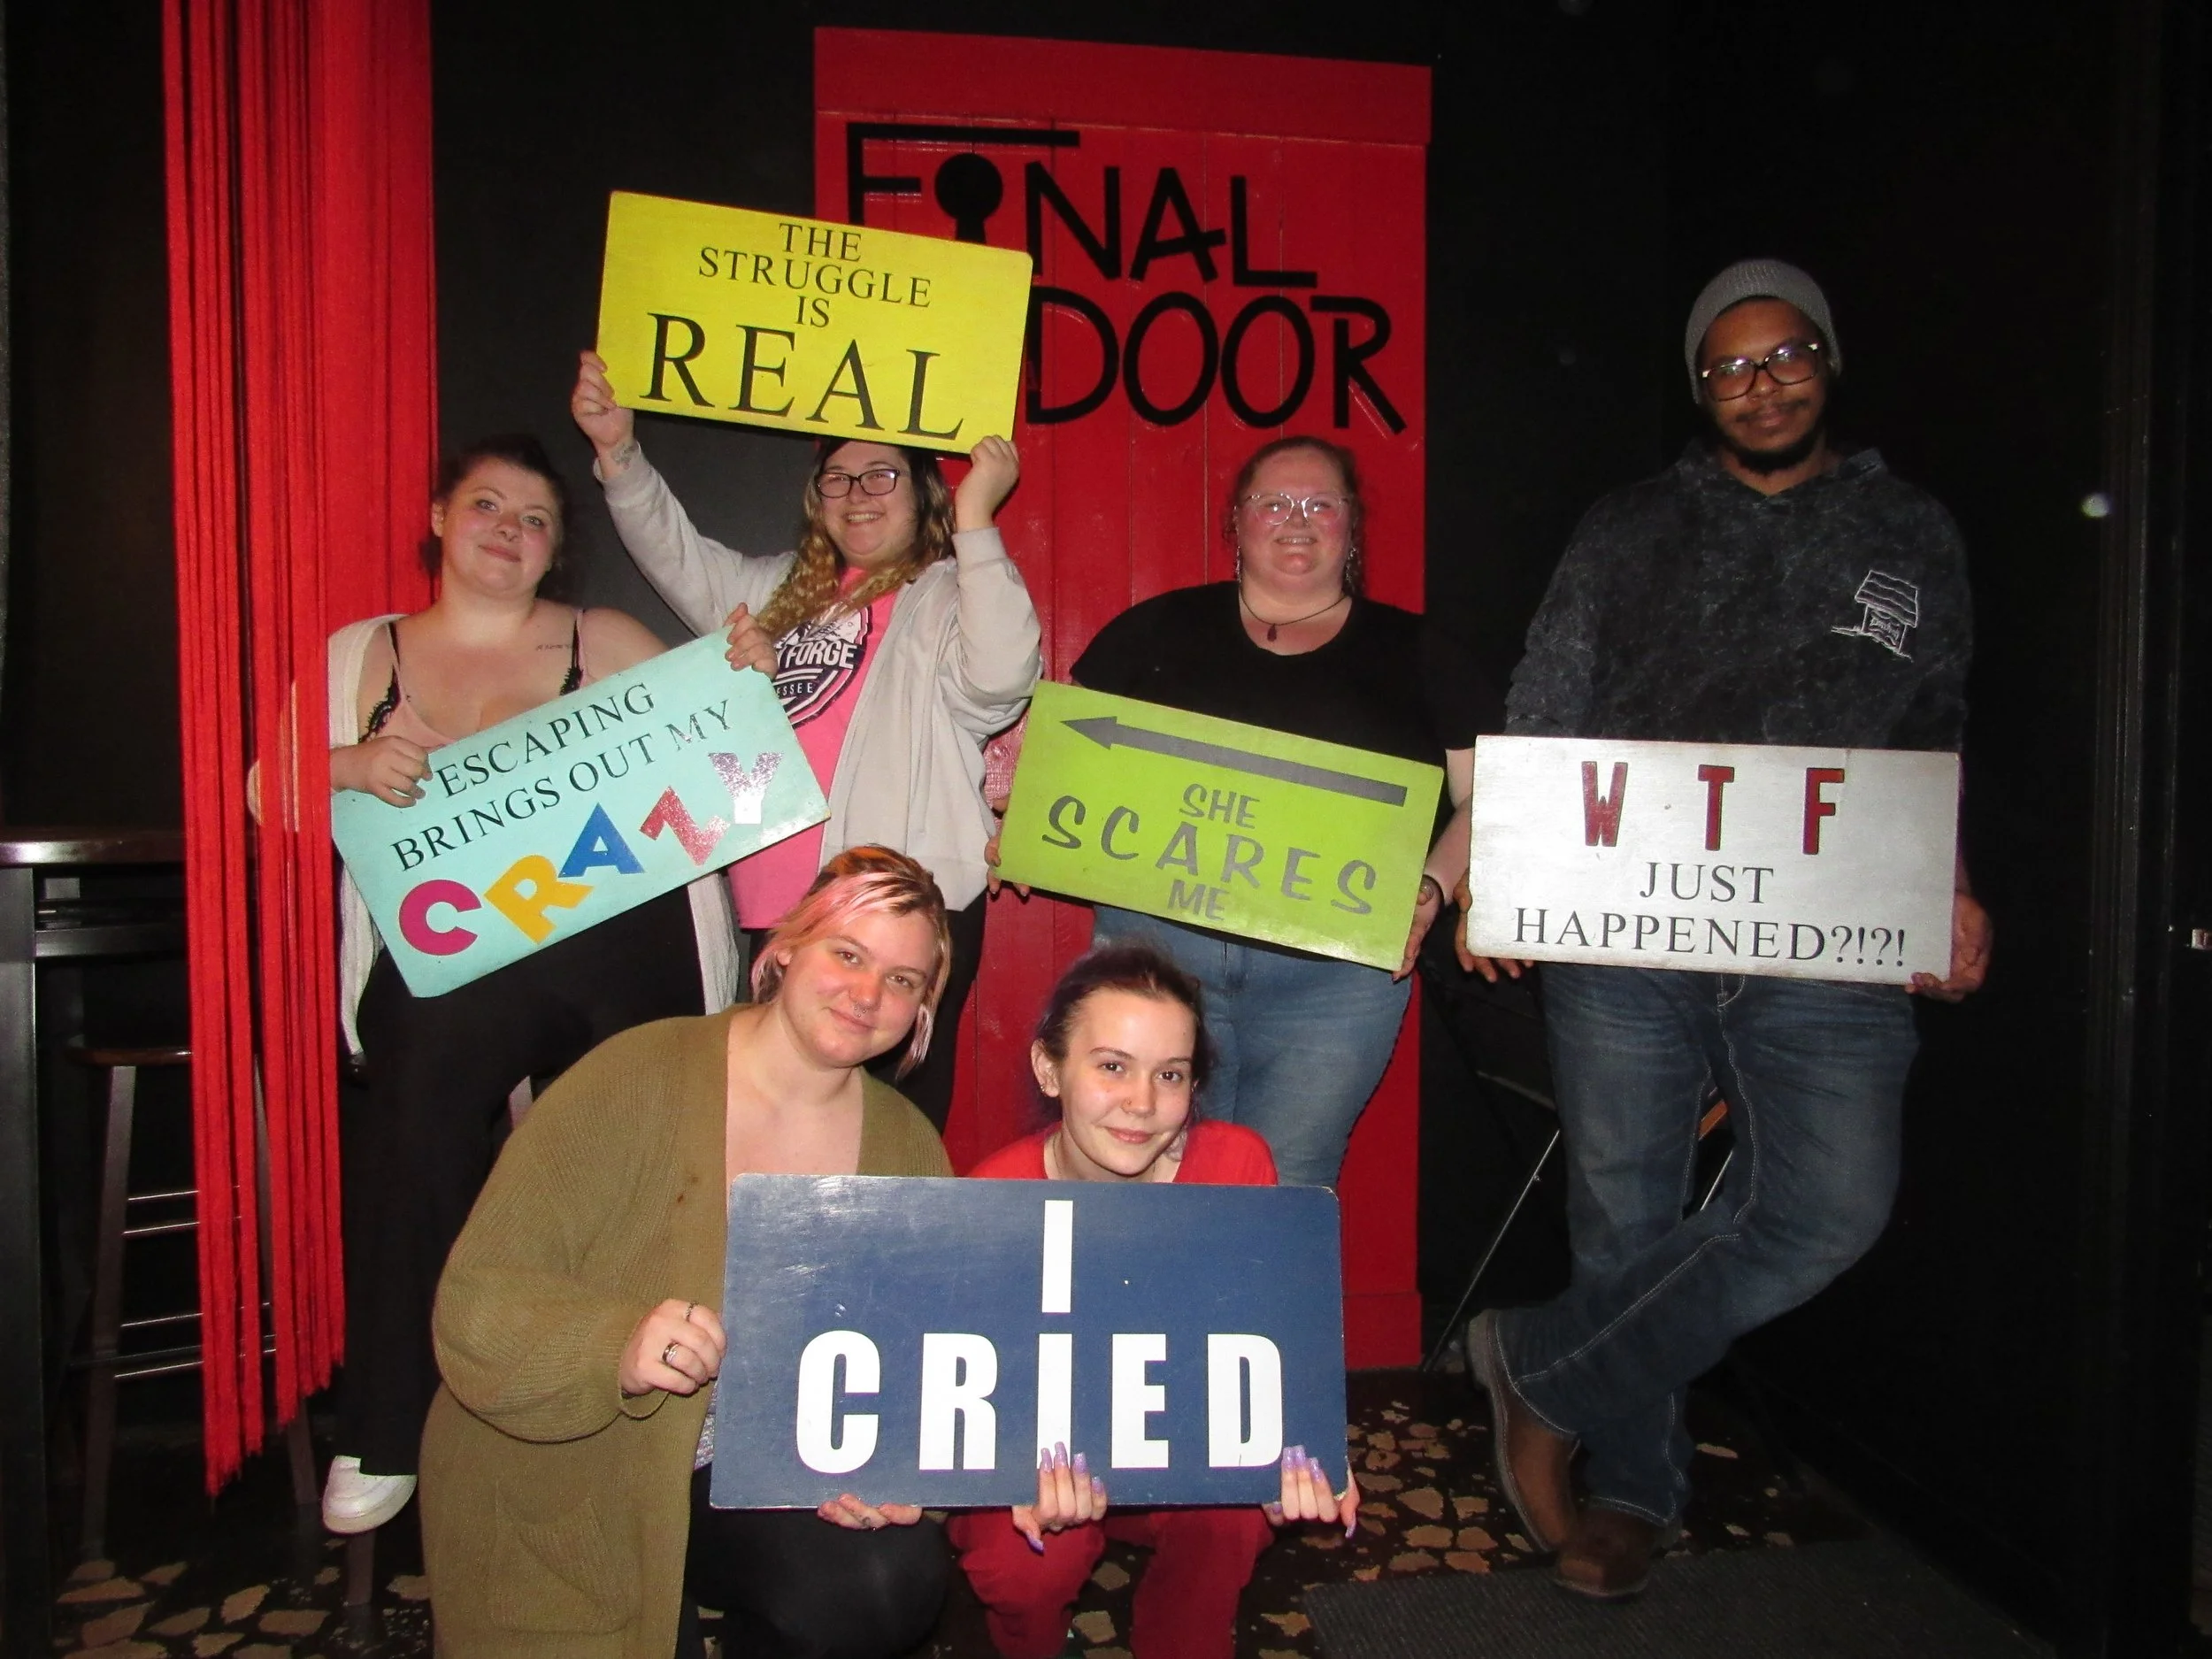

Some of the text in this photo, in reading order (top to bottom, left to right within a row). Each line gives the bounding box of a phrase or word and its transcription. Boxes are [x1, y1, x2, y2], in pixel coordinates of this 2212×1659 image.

[699, 246, 932, 308] STRUGGLE
[779, 222, 862, 262] THE
[795, 296, 830, 328] IS
[639, 312, 964, 442] REAL
[1025, 285, 1406, 434] DOOR
[785, 641, 857, 670] FORGE
[435, 681, 655, 798] ESCAPING
[390, 700, 733, 872] BRINGS OUT MY
[1179, 783, 1260, 829] SHE
[398, 752, 783, 956] CRAZY
[1041, 795, 1377, 915] SCARES
[1639, 862, 1774, 903] JUST
[1167, 879, 1230, 921] ME
[1512, 908, 1906, 967] HAPPENED?!?!
[1041, 1200, 1074, 1314] I
[795, 1330, 1285, 1475] CRIED
